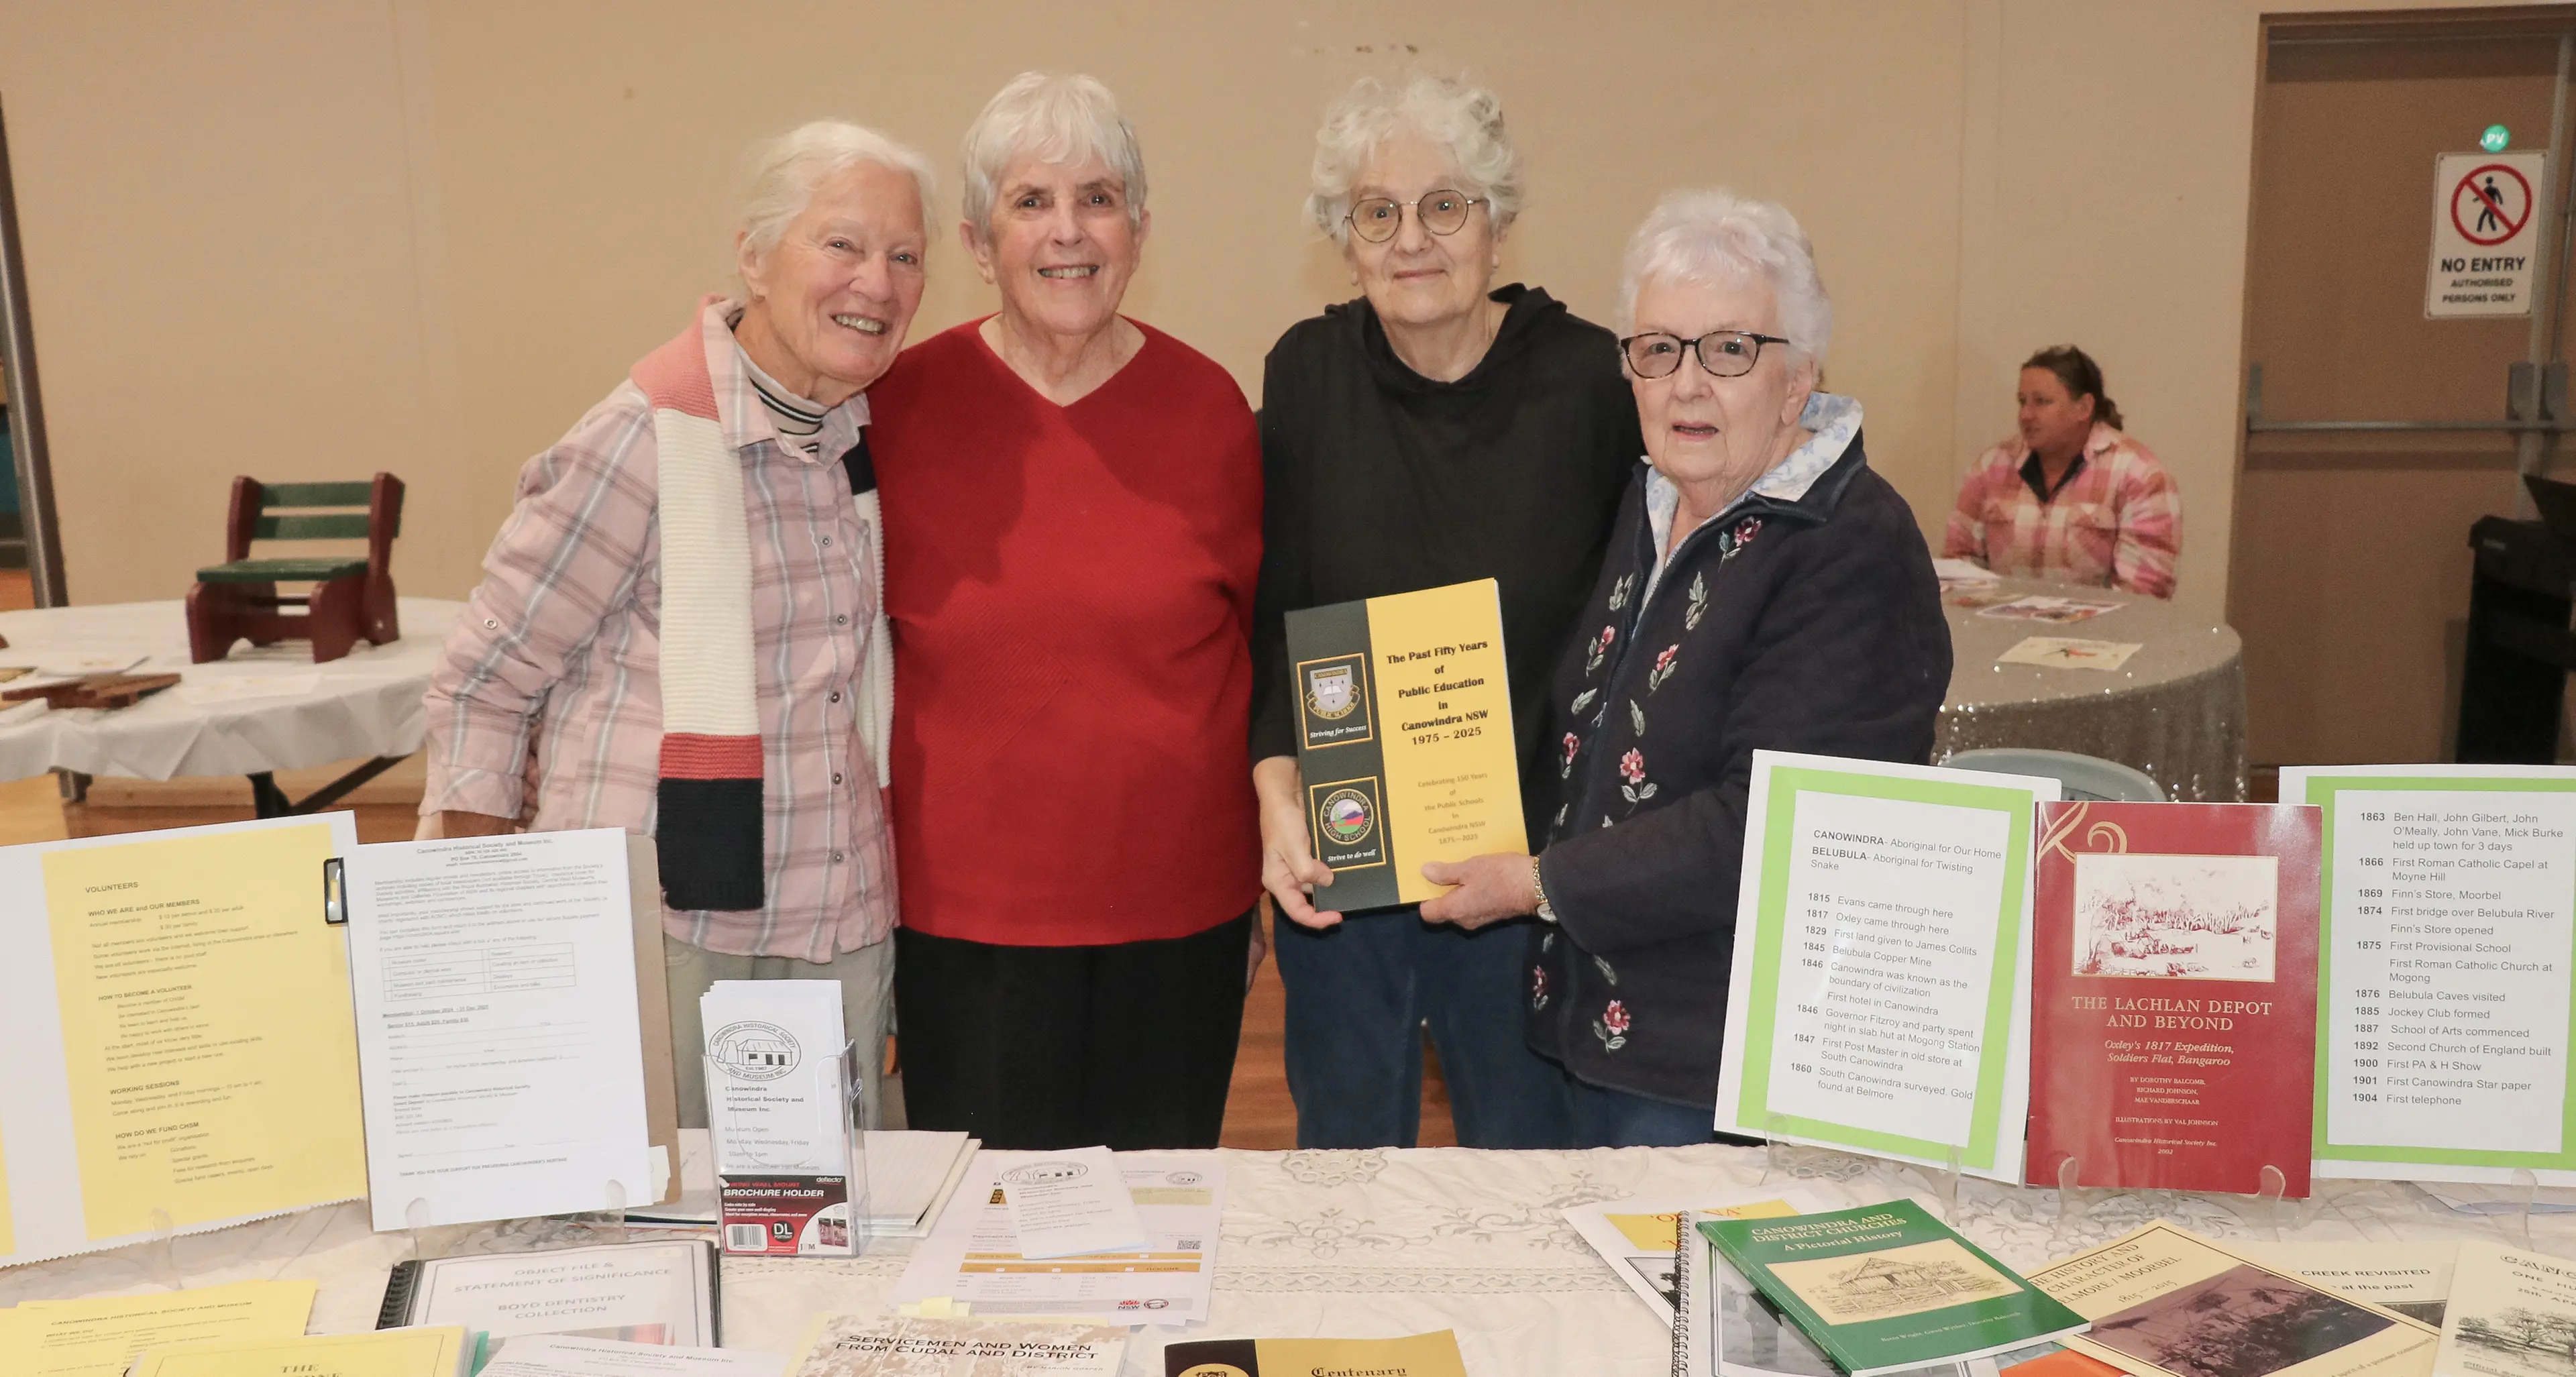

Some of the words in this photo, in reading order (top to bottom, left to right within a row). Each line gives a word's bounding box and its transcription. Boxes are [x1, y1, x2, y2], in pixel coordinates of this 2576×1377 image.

[2441, 258, 2465, 272] NO
[2471, 257, 2525, 272] ENTRY
[2451, 278, 2513, 287] AUTHORISED
[2443, 294, 2487, 302] PERSONS
[2491, 294, 2515, 302] ONLY
[1387, 655, 1405, 663] The
[1409, 650, 1431, 660] Past
[1434, 647, 1456, 656] Fifty
[1459, 641, 1487, 651] Years
[1435, 665, 1444, 674] of
[1399, 686, 1430, 698] Public
[1434, 678, 1484, 692] Education
[1402, 716, 1462, 730] Canowindra
[1466, 710, 1487, 720] NSW
[1310, 730, 1334, 738] Striving
[1334, 728, 1345, 736] for
[1346, 725, 1367, 733] Success
[1412, 733, 1439, 745] 1975
[1454, 727, 1481, 738] 2025
[1324, 791, 1369, 817] CANOWINDRA
[2361, 812, 2385, 821] 1863
[2394, 812, 2414, 822] Ben
[2417, 812, 2439, 824] Hall,
[2443, 813, 2468, 822] John
[2471, 813, 2509, 824] Gilbert,
[2512, 814, 2538, 823] John
[1325, 822, 1342, 840] HIGH
[1344, 816, 1371, 841] SCHOOL
[2443, 827, 2468, 836] John
[2471, 827, 2501, 837] Vane,
[2504, 828, 2528, 837] Mick
[2532, 828, 2563, 837] Burke
[1813, 829, 1888, 846] CANOWINDRA-
[1890, 838, 1936, 851] Aboriginal
[1939, 843, 1951, 852] for
[1953, 845, 1971, 855] Our
[1974, 847, 2001, 859] Home
[2393, 840, 2414, 849] held
[2418, 842, 2430, 852] up
[2433, 841, 2458, 850] town
[2461, 841, 2475, 850] for
[2478, 841, 2484, 850] 3
[2487, 842, 2512, 852] days
[1811, 859, 1839, 871] Snake
[1812, 846, 1870, 861] BELUBULA-
[1872, 853, 1919, 867] Aboriginal
[1921, 859, 1933, 868] for
[1935, 860, 1973, 875] Twisting
[2359, 857, 2383, 866] 1866
[2392, 857, 2415, 867] First
[2418, 858, 2455, 867] Roman
[2458, 859, 2500, 869] Catholic
[2503, 859, 2534, 870] Capel
[2537, 861, 2548, 869] at
[2392, 871, 2426, 883] Moyne
[2430, 871, 2445, 881] Hill
[85, 881, 138, 893] VOLUNTEERS
[2359, 889, 2383, 897] 1869
[2392, 889, 2422, 898] Finn's
[2424, 889, 2455, 900] Store,
[2459, 890, 2501, 900] Moorbel
[166, 899, 200, 907] MEMBERS
[1808, 892, 1830, 903] 1815
[1837, 895, 1866, 907] Evans
[1868, 901, 1892, 911] came
[1895, 903, 1929, 917] through
[1932, 907, 1953, 919] here
[2358, 905, 2382, 915] 1874
[2391, 906, 2413, 916] First
[2416, 907, 2448, 918] bridge
[2477, 907, 2523, 918] Belubula
[2526, 909, 2555, 919] River
[1807, 909, 1828, 919] 1817
[1835, 912, 1862, 925] Oxley
[1864, 918, 1888, 927] came
[1891, 920, 1925, 934] through
[1928, 924, 1949, 935] here
[1805, 925, 1827, 936] 1829
[1834, 928, 1854, 940] First
[1856, 932, 1876, 942] land
[1877, 935, 1902, 947] given
[1904, 938, 1913, 947] to
[1915, 940, 1946, 952] James
[1949, 944, 1977, 956] Collits
[1803, 942, 1825, 952] 1845
[1832, 945, 1871, 958] Belubula
[1873, 950, 1907, 964] Copper
[1909, 955, 1932, 967] Mine
[2072, 996, 2106, 1009] THE
[2114, 997, 2201, 1013] LACHLAN
[2208, 1000, 2272, 1015] DEPOT
[2106, 1014, 2147, 1028] AND
[2154, 1015, 2233, 1030] BEYOND
[2104, 1040, 2141, 1052] Oxley's
[2145, 1040, 2172, 1050] 1817
[2173, 1042, 2234, 1054] Expedition,
[2107, 1052, 2149, 1062] Soldiers
[2151, 1054, 2174, 1064] Flat,
[2176, 1054, 2231, 1067] Bangaroo
[723, 1189, 781, 1197] BROCHURE
[773, 1223, 793, 1235] DL
[1752, 1219, 1858, 1235] CANOWINDRA
[1861, 1213, 1893, 1223] AND
[1753, 1229, 1823, 1242] DISTRICT
[1826, 1218, 1907, 1235] CHURCHES
[1796, 1237, 1852, 1250] Pictorial
[1853, 1230, 1902, 1243] History
[2052, 1255, 2108, 1279] HISTORY
[2110, 1244, 2139, 1258] AND
[2119, 1256, 2182, 1280] MOORBEL
[514, 1266, 566, 1275] OBJECT
[2047, 1261, 2127, 1293] CHARACTER
[2127, 1253, 2146, 1264] OF
[454, 1279, 541, 1292] STATEMENT
[572, 1269, 669, 1282] SIGNIFICANCE
[498, 1302, 540, 1311] BOYD
[545, 1294, 625, 1307] DENTISTRY
[515, 1305, 606, 1319] COLLECTION
[835, 1342, 888, 1353] FROM
[896, 1345, 959, 1356] CUDAL
[1011, 1350, 1098, 1359] DISTRICT
[846, 1335, 966, 1347] SERVICEMEN
[1019, 1343, 1091, 1352] WOMEN
